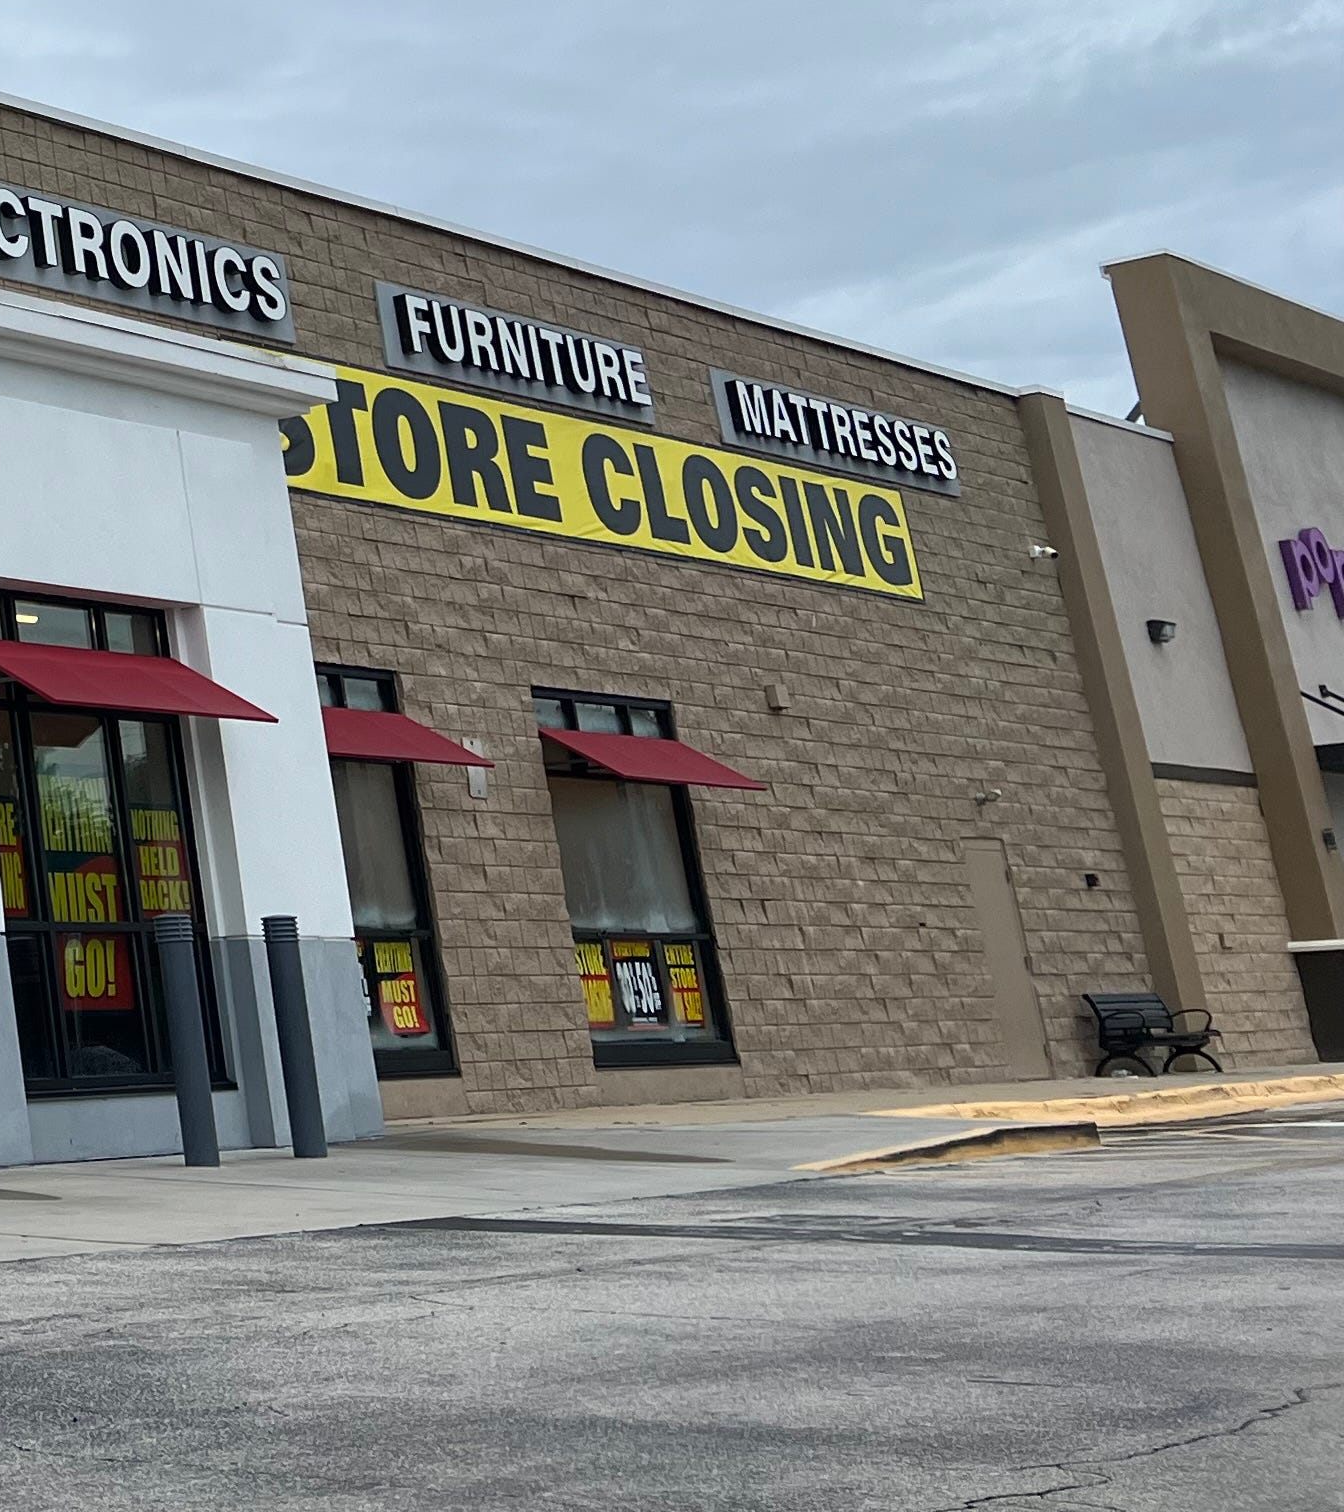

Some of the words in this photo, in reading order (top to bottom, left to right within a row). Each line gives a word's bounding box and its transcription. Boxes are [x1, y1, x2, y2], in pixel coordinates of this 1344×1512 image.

[393, 291, 653, 411] FURNITURE
[722, 378, 959, 483] MATTRESSES
[580, 432, 915, 587] CLOSING
[130, 808, 180, 841] NOTHING
[139, 845, 180, 876] HELD
[139, 879, 191, 911] BACK!
[64, 938, 116, 998] GO!
[380, 980, 416, 1003] MUST
[393, 1005, 420, 1028] GO!
